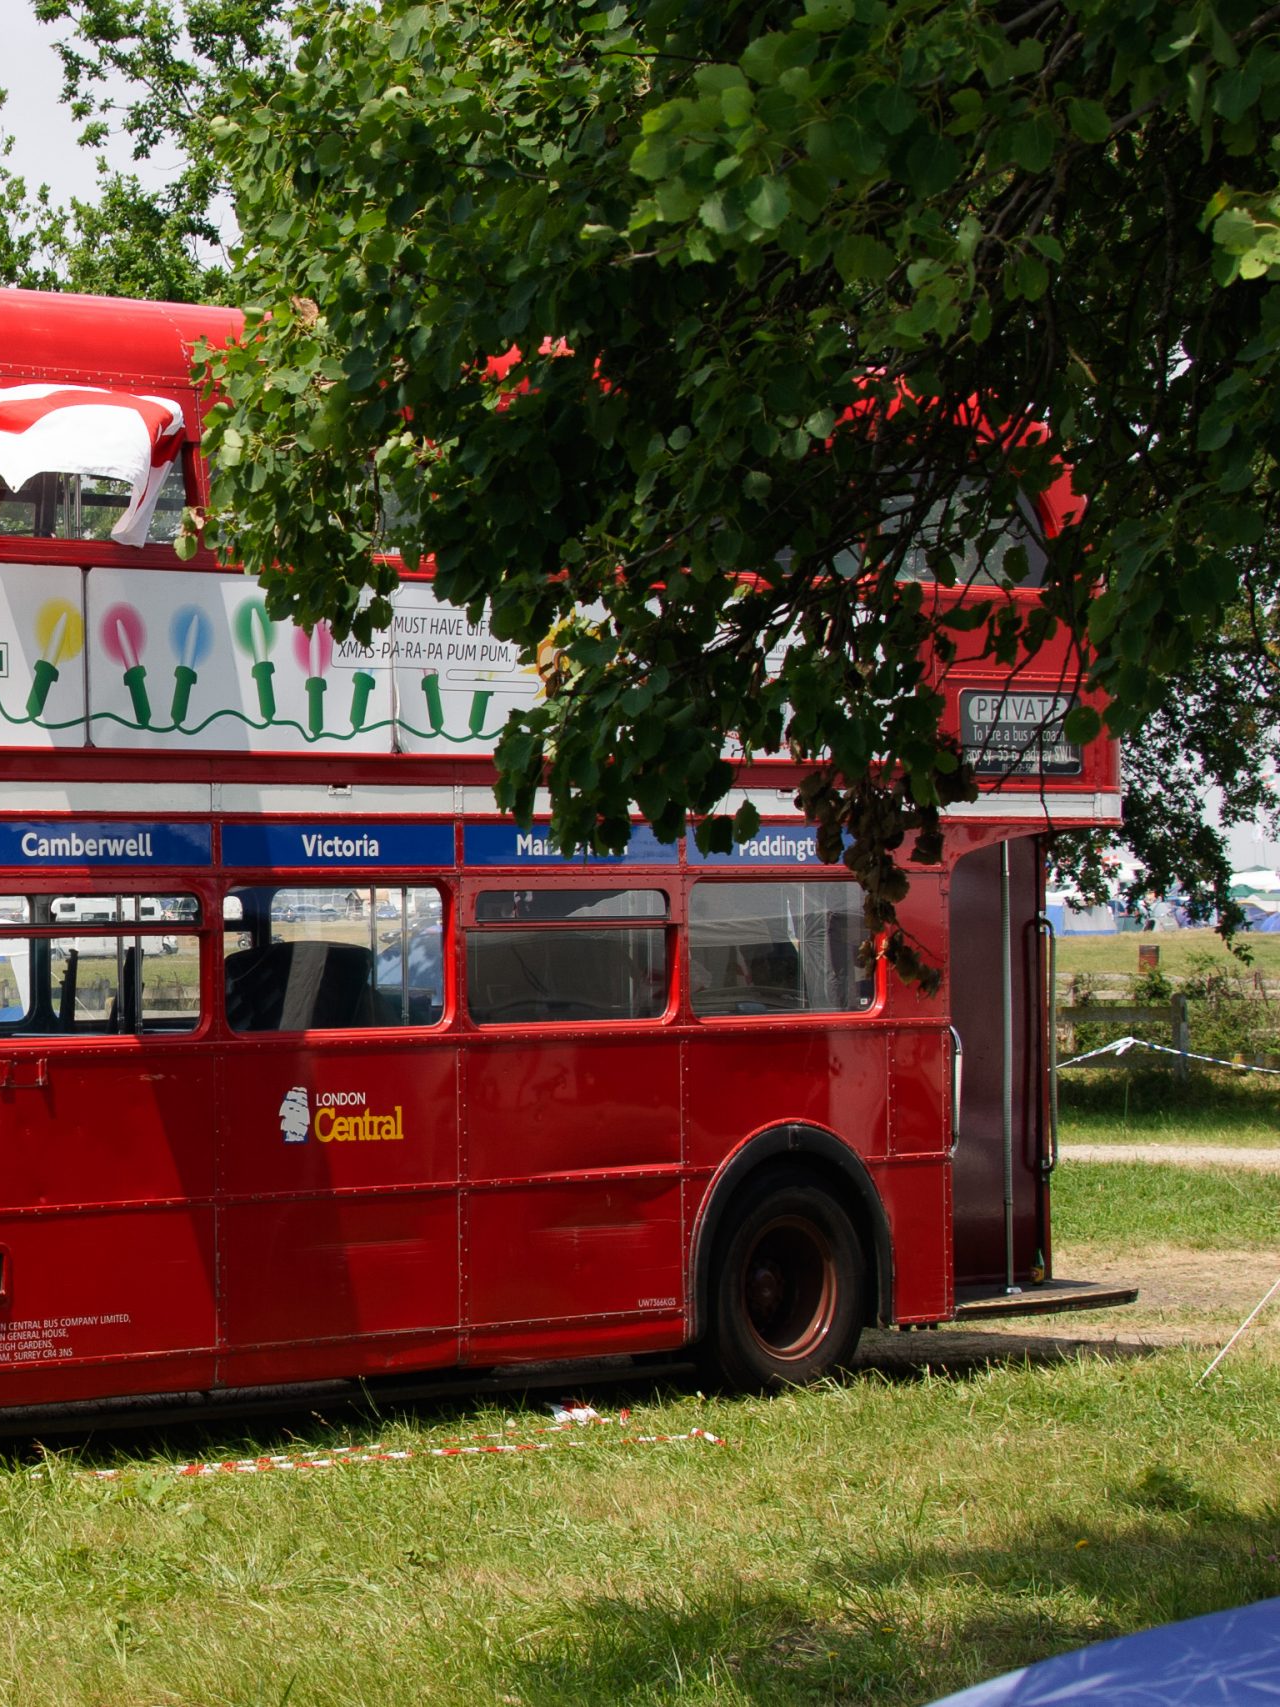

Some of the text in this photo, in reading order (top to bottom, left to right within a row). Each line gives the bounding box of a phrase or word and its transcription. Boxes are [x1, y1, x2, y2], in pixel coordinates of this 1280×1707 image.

[394, 616, 427, 634] MUST
[430, 618, 464, 635] HAVE
[447, 644, 477, 661] PUM
[480, 645, 512, 662] PUM.
[1013, 725, 1028, 741] bus
[21, 832, 153, 857] Camberwell
[301, 834, 380, 857] Victoria
[739, 835, 817, 861] Paddingt
[316, 1092, 366, 1106] LONDON
[314, 1106, 404, 1143] Central
[8, 1320, 41, 1331] CENTRAL
[43, 1319, 58, 1328] BUS
[60, 1316, 99, 1326] COMPANY
[7, 1331, 40, 1340] GENERAL
[18, 1339, 54, 1350] GARDENS,
[14, 1350, 41, 1361] SURREY
[43, 1349, 57, 1358] CR4
[58, 1347, 73, 1357] 3NS
